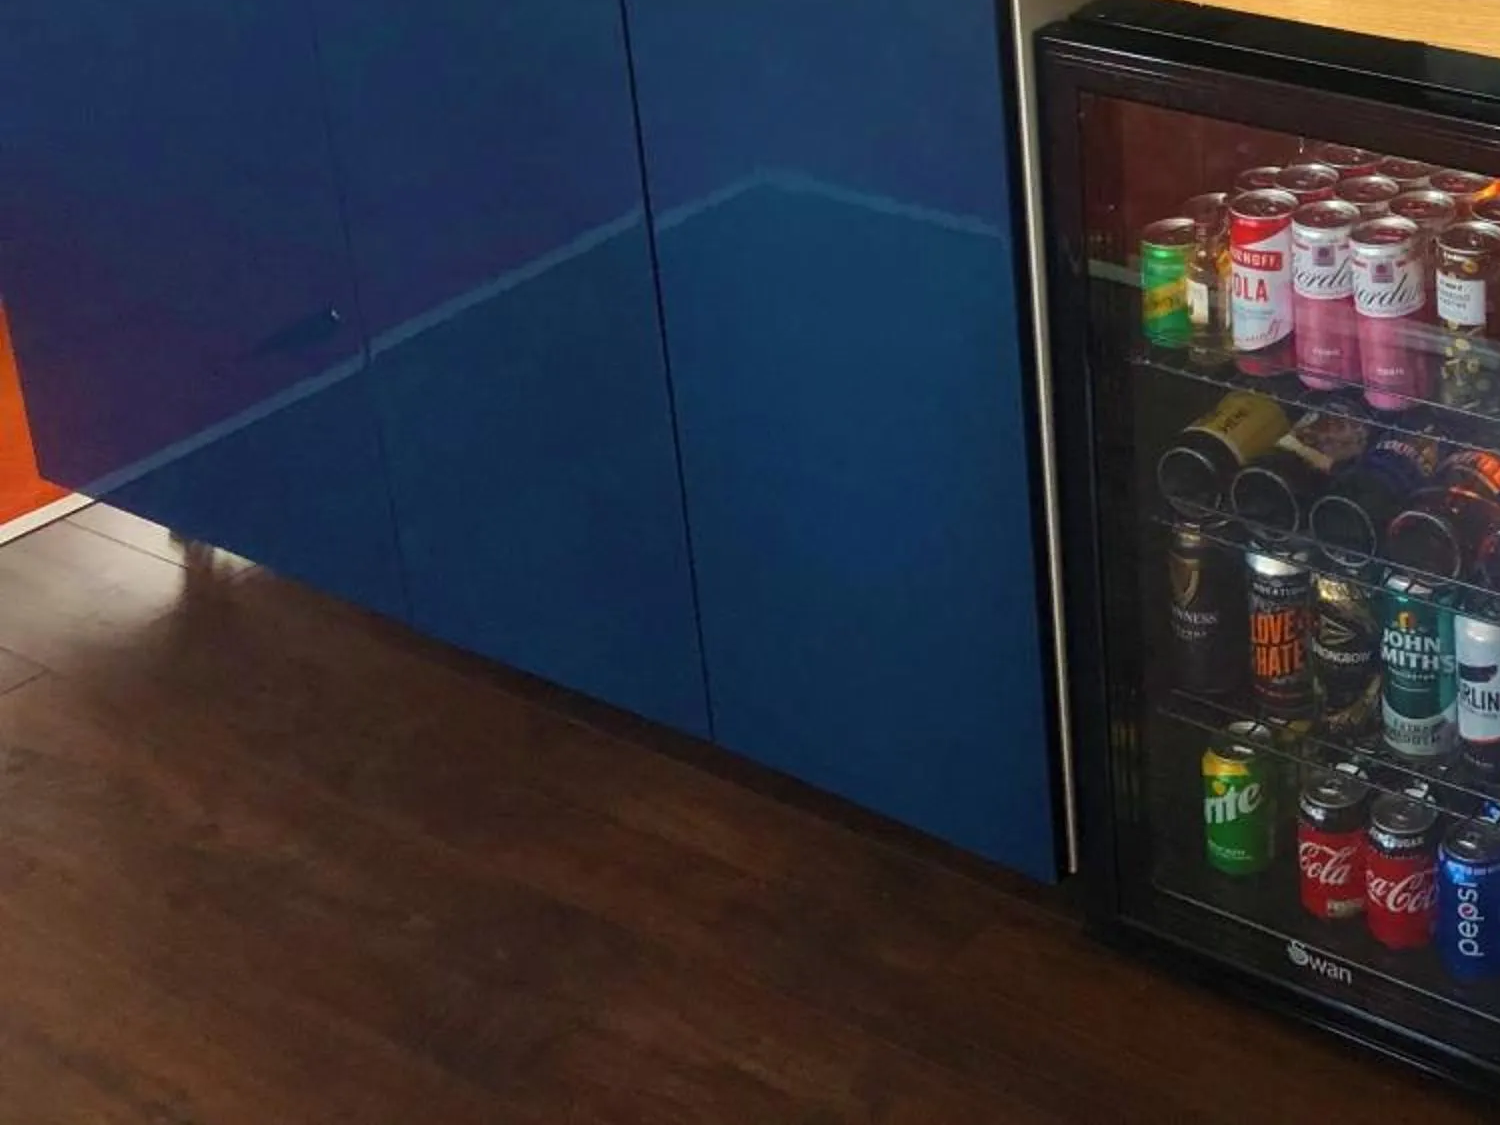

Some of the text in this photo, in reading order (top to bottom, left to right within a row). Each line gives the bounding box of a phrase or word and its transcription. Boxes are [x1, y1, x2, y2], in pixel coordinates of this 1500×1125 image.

[1233, 272, 1270, 303] OLA
[1250, 609, 1297, 645] LOVE
[1382, 627, 1441, 653] JOHN
[1255, 639, 1307, 679] HATE
[1202, 780, 1263, 824] rite
[1457, 881, 1485, 957] pepsi
[1287, 939, 1353, 987] Swan
